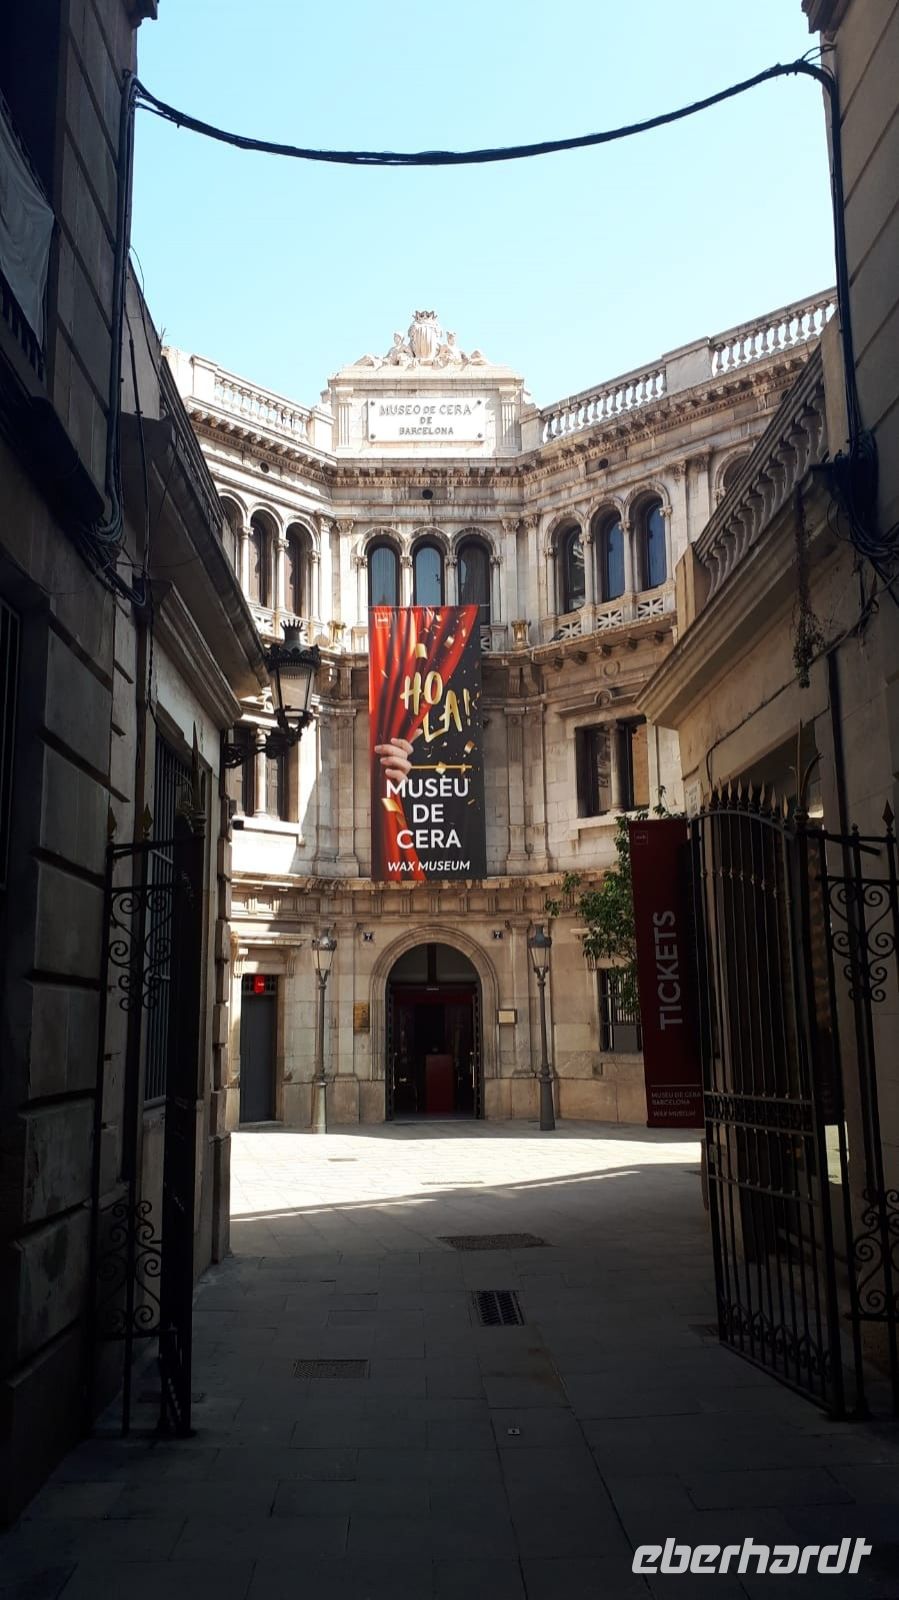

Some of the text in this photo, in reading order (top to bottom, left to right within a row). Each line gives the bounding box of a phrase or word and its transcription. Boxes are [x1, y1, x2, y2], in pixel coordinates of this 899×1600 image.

[379, 404, 472, 416] MUSEO DE CERA
[420, 416, 432, 424] DE
[399, 427, 454, 435] BARCELONA
[386, 778, 469, 798] MUSEU
[413, 804, 444, 823] DE
[396, 829, 462, 849] CERA
[387, 860, 471, 872] WAX MUSEUM
[652, 910, 683, 1031] TICKETS
